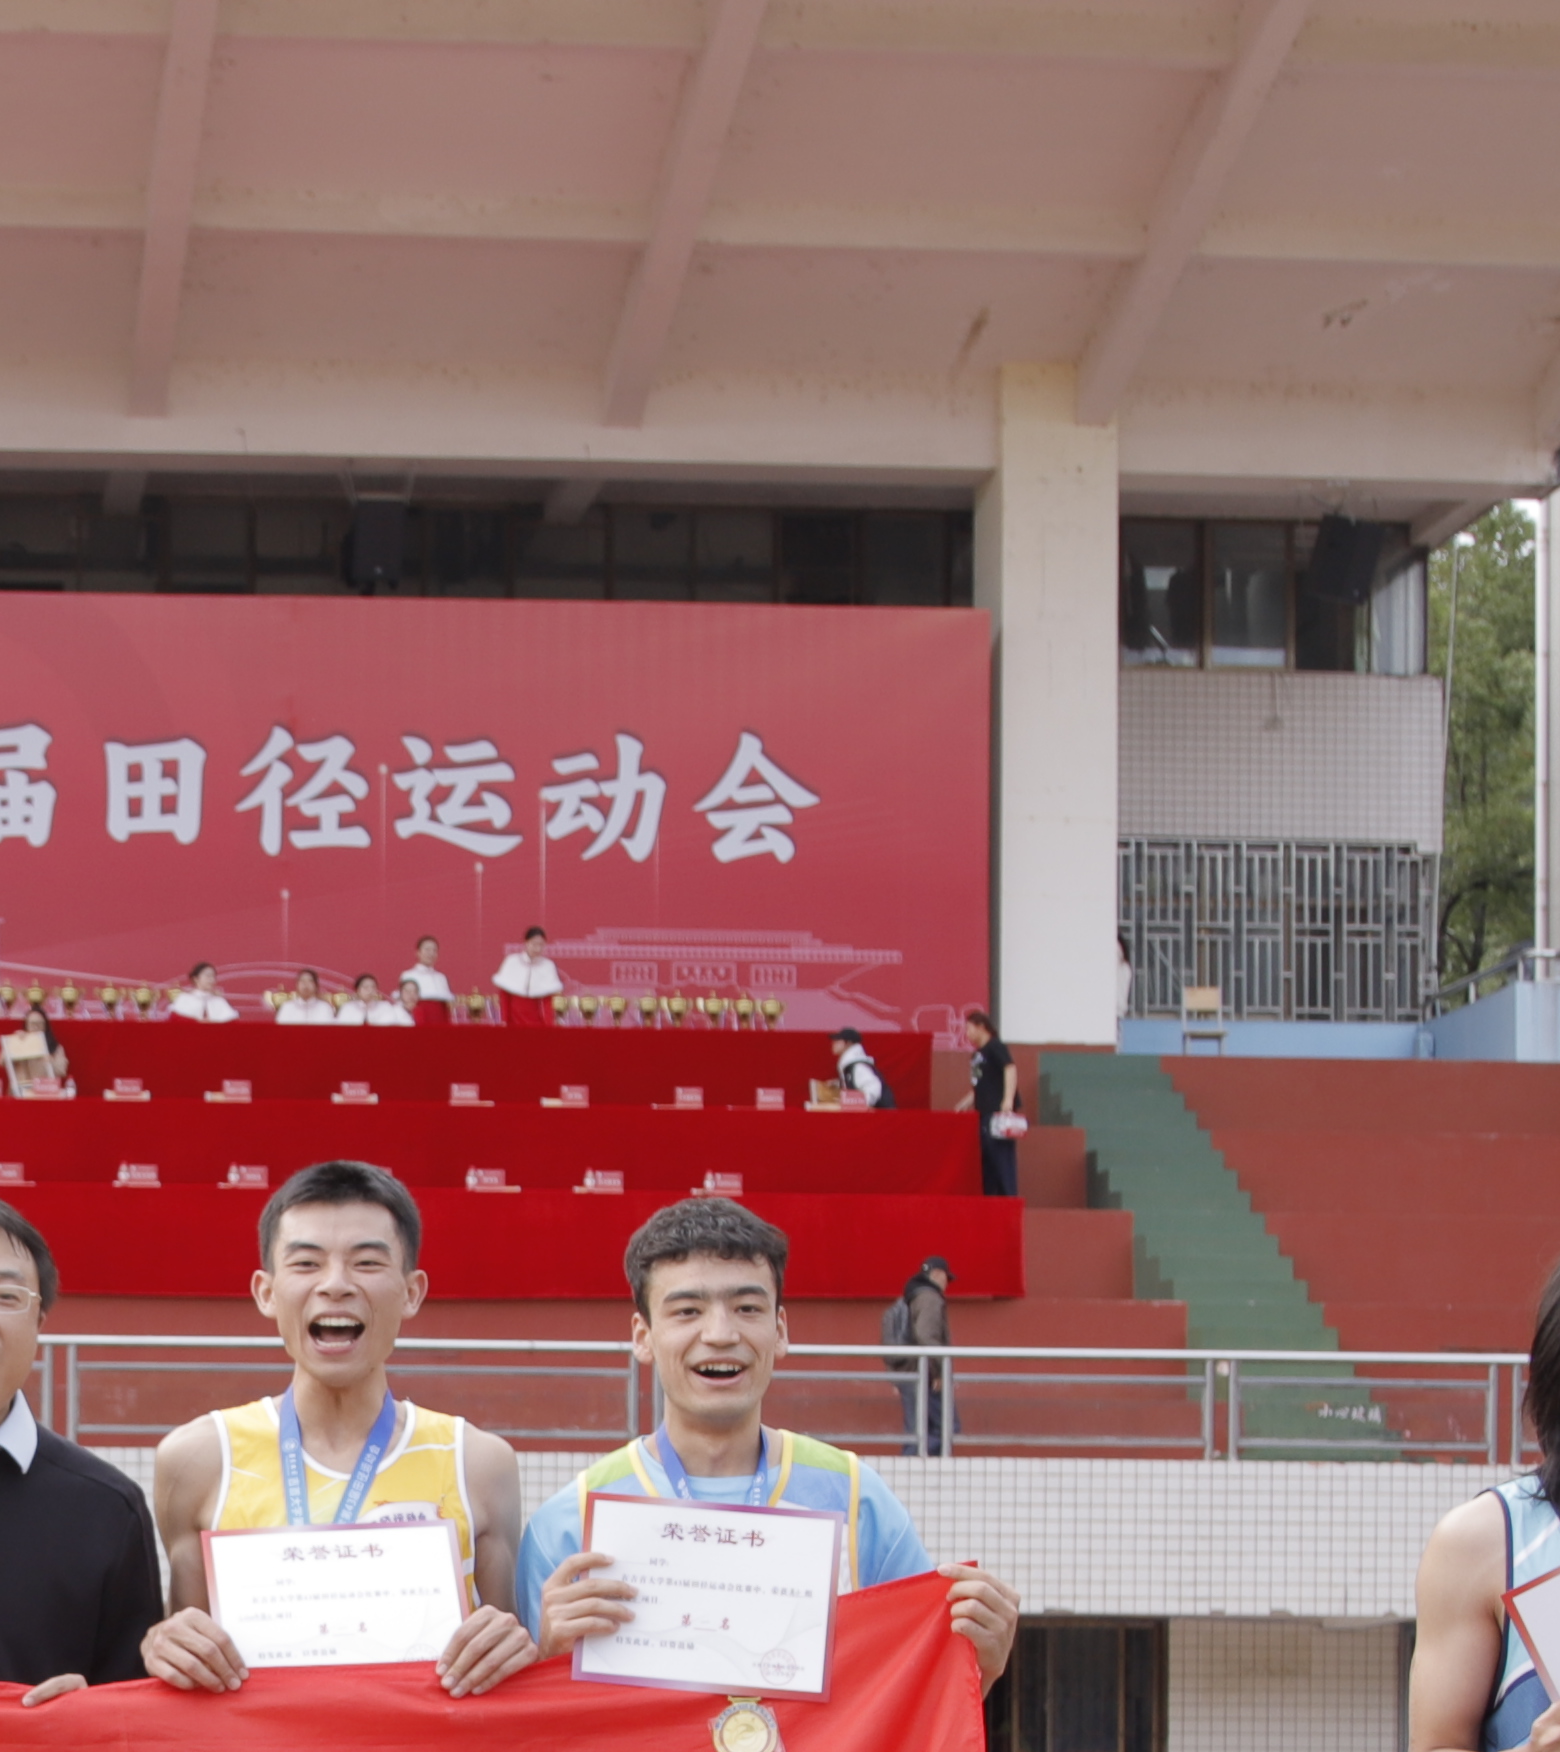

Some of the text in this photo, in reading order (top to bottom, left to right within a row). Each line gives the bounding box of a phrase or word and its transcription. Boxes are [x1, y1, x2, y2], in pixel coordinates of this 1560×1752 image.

[661, 1522, 766, 1548] 荣誉证书
[282, 1543, 384, 1562] 荣誉证书
